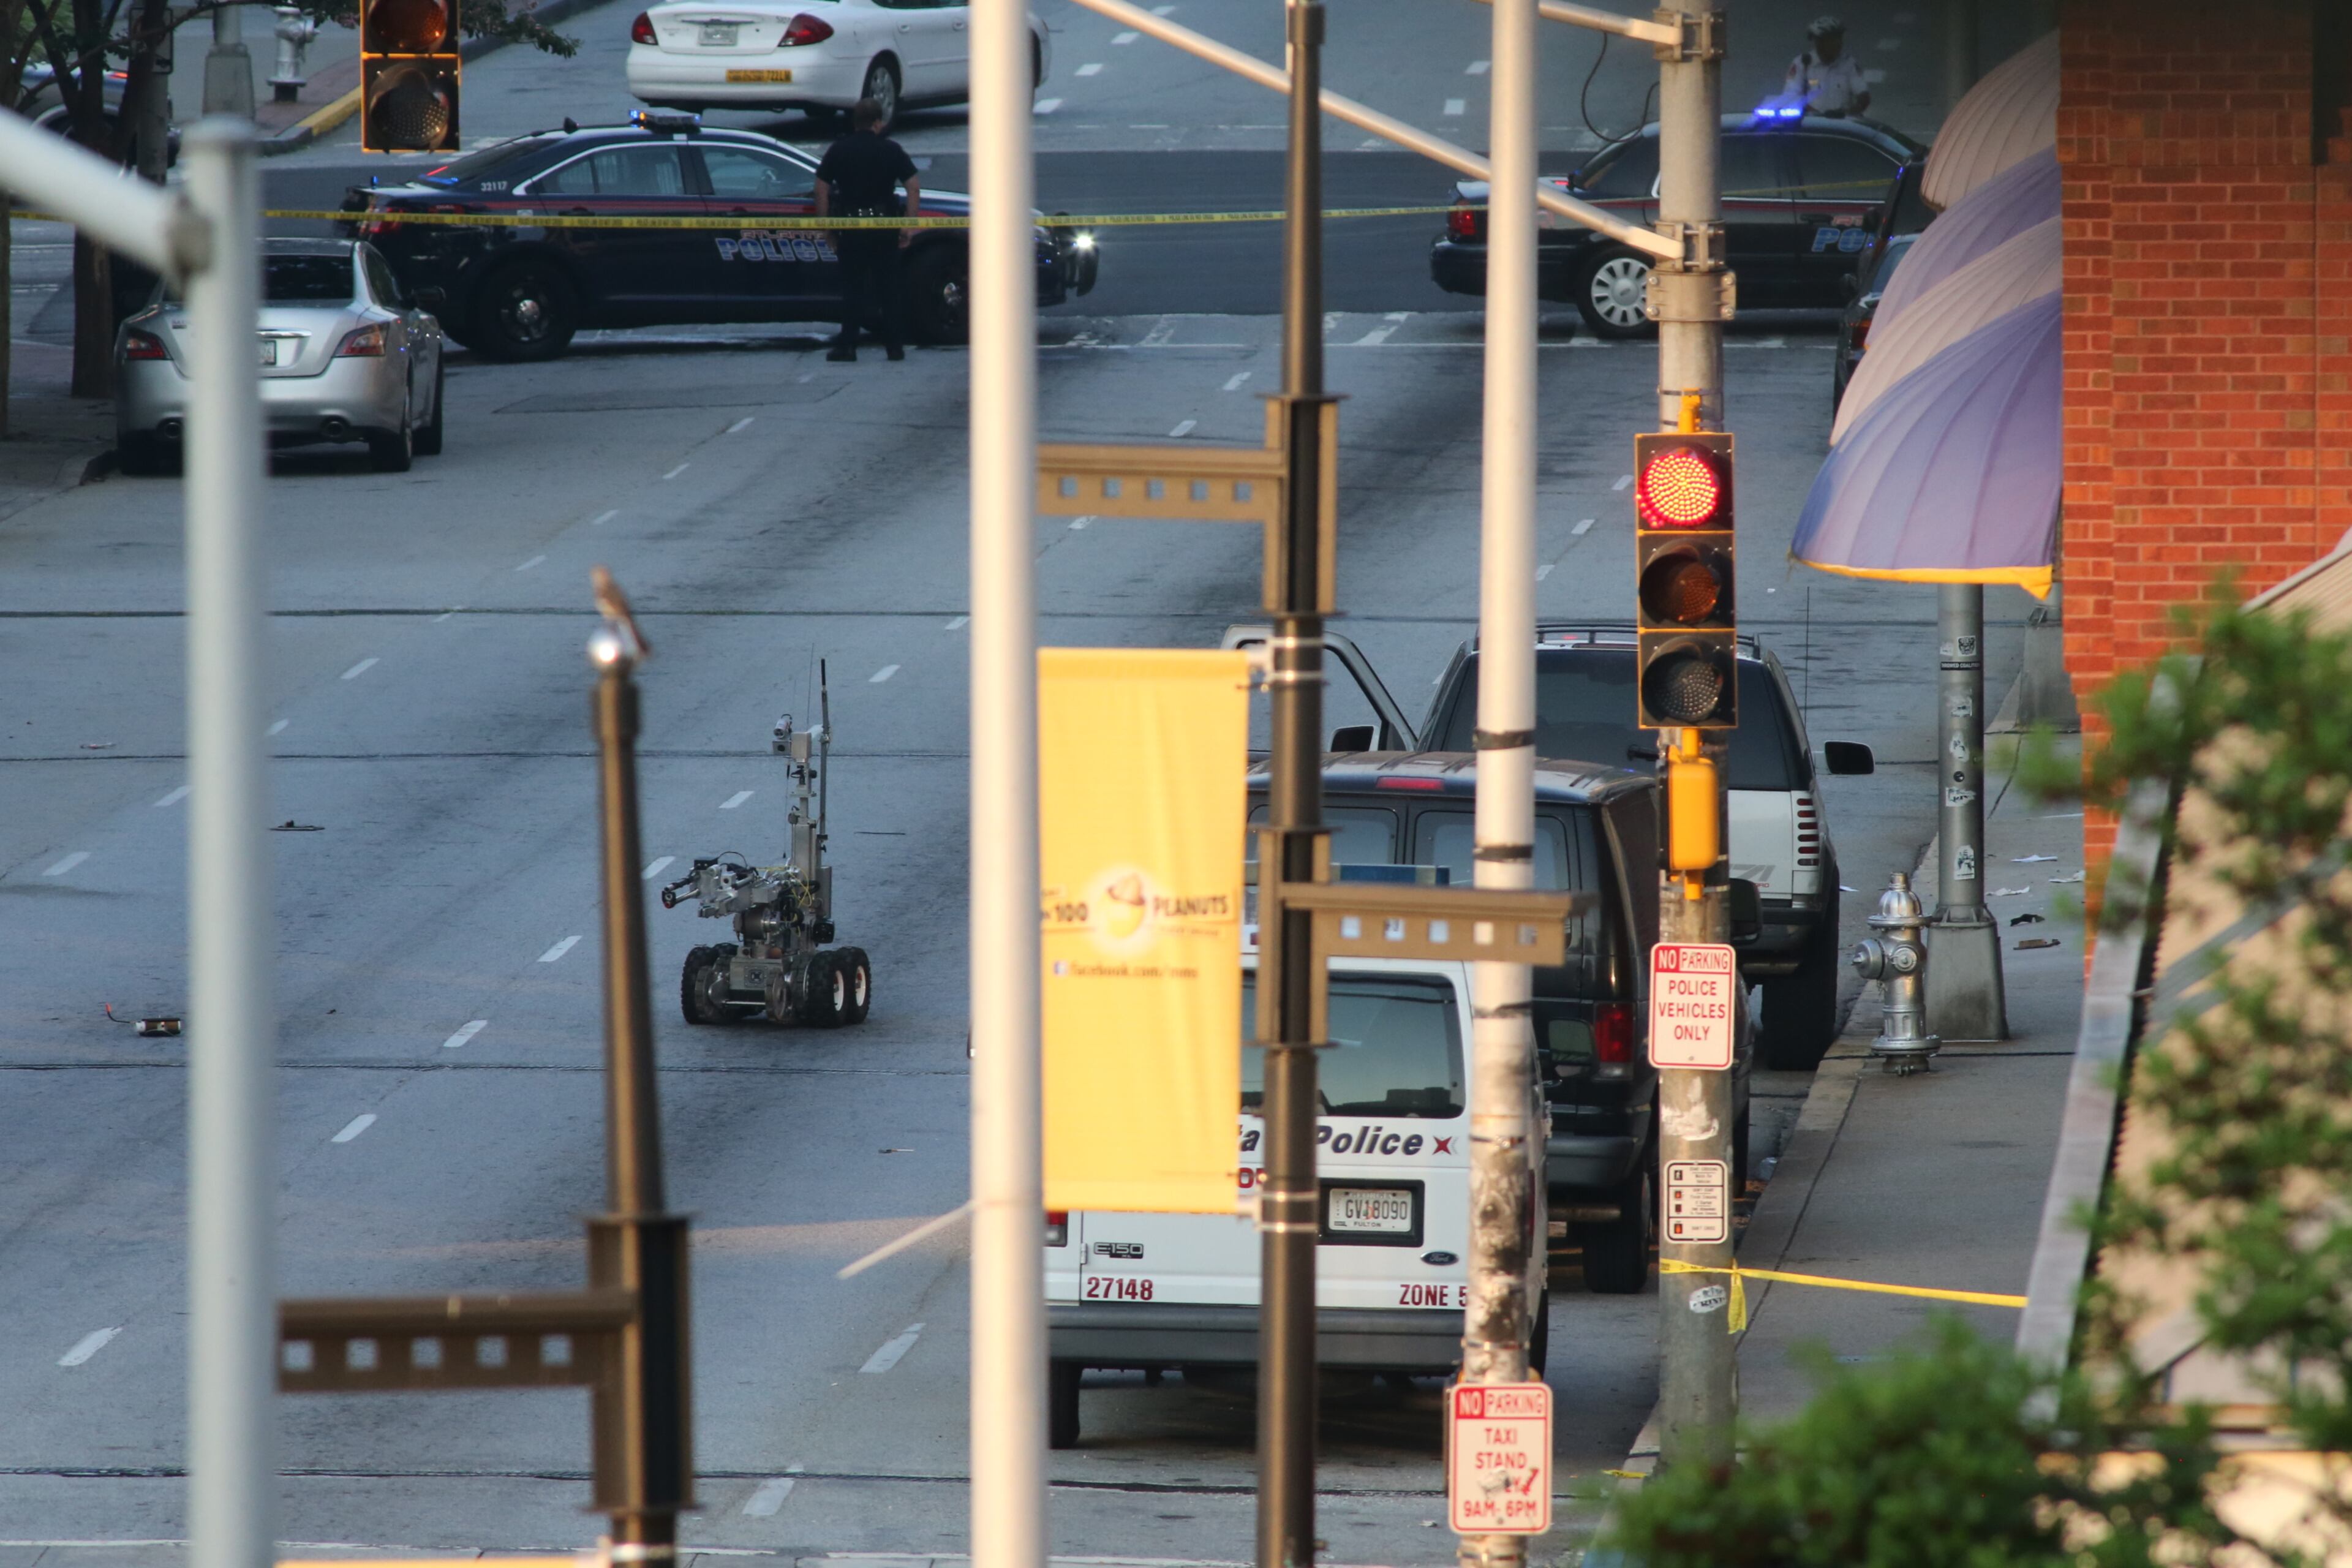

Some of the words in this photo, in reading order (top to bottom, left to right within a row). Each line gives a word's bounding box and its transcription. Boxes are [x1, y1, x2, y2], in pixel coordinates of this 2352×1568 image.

[481, 181, 508, 191] 32117
[715, 238, 839, 262] POLICE
[1153, 895, 1227, 917] PEANUTS
[1658, 949, 1678, 970] NO
[1681, 952, 1728, 970] PARKING
[1668, 979, 1717, 996] POLICE
[1658, 1002, 1726, 1019] VEHICLES
[1674, 1025, 1710, 1040] ONLY
[1316, 1125, 1424, 1156] Police
[1345, 1199, 1408, 1220] GV18090
[1087, 1276, 1153, 1301] 27148
[1399, 1284, 1449, 1306] ZONE
[1459, 1286, 1468, 1307] 5
[1460, 1390, 1483, 1416] NO
[1486, 1393, 1542, 1414] PARKING
[1484, 1428, 1518, 1444] TAXI
[1476, 1452, 1527, 1469] STAND
[1506, 1501, 1537, 1517] 6PM
